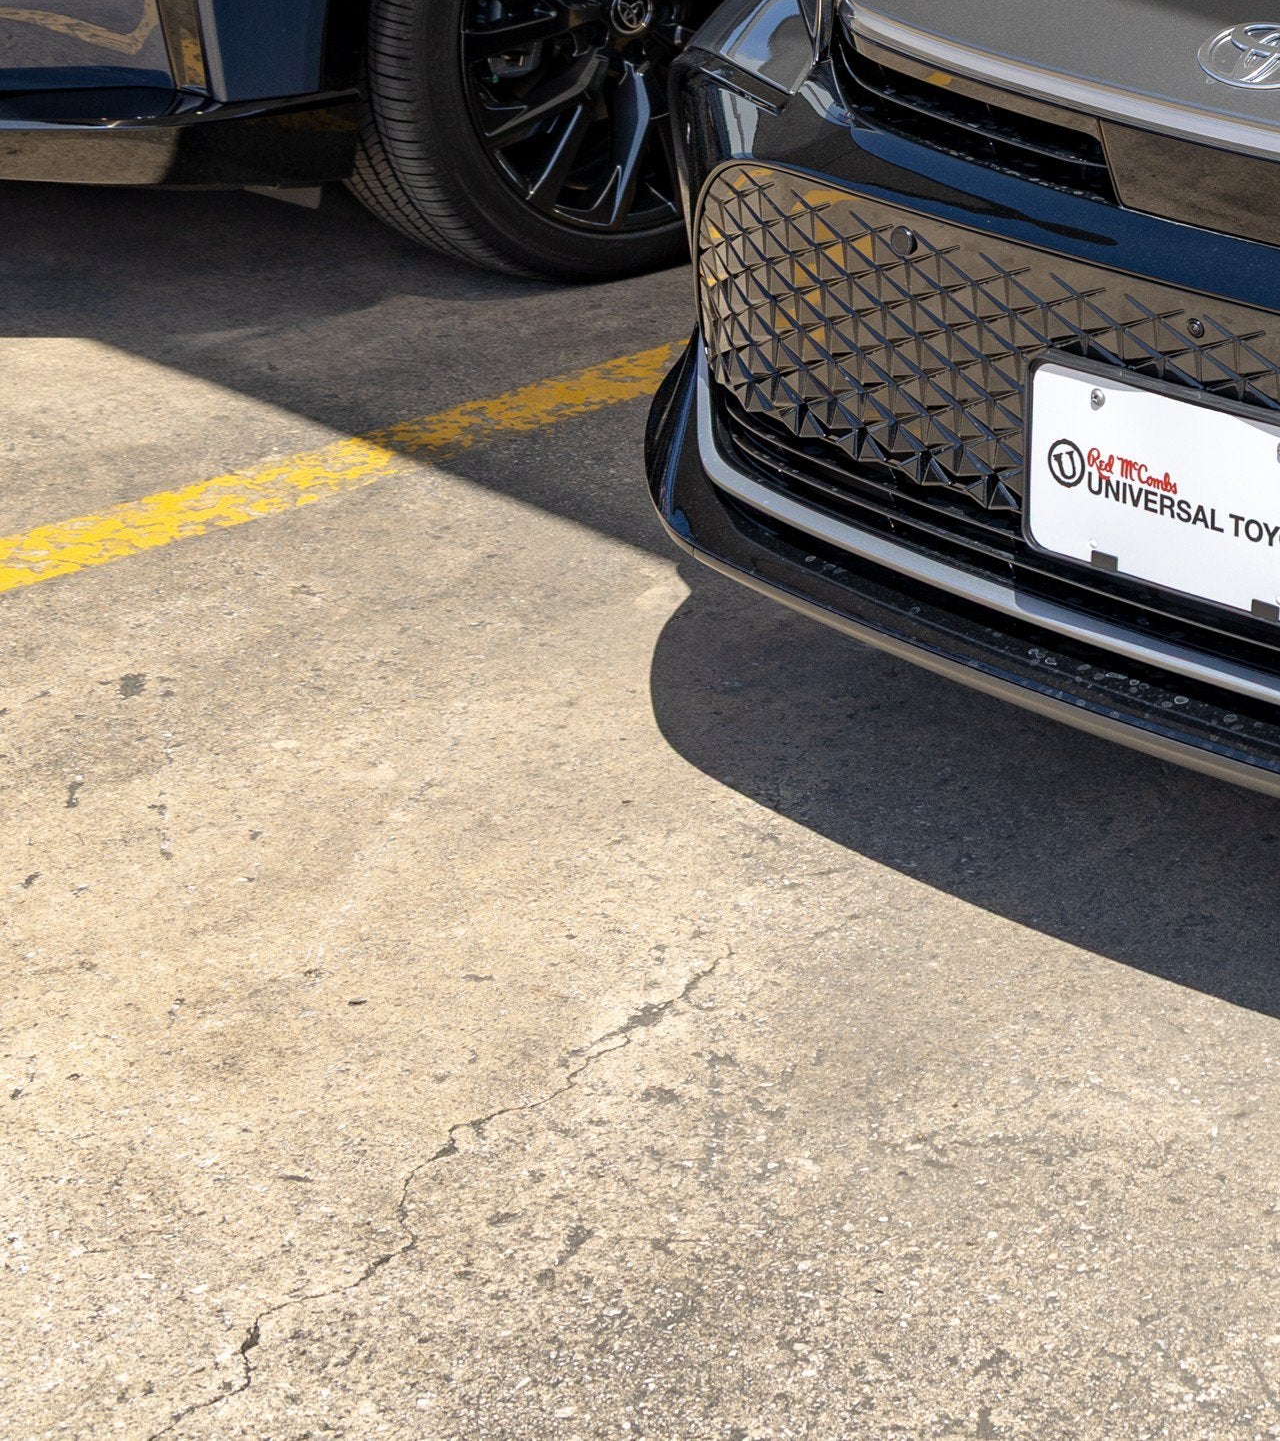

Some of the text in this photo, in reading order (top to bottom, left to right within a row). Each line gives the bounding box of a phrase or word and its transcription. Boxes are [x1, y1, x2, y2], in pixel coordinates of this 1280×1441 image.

[1087, 447, 1178, 495] Red McCombs
[1087, 471, 1225, 534] UNIVERSAL
